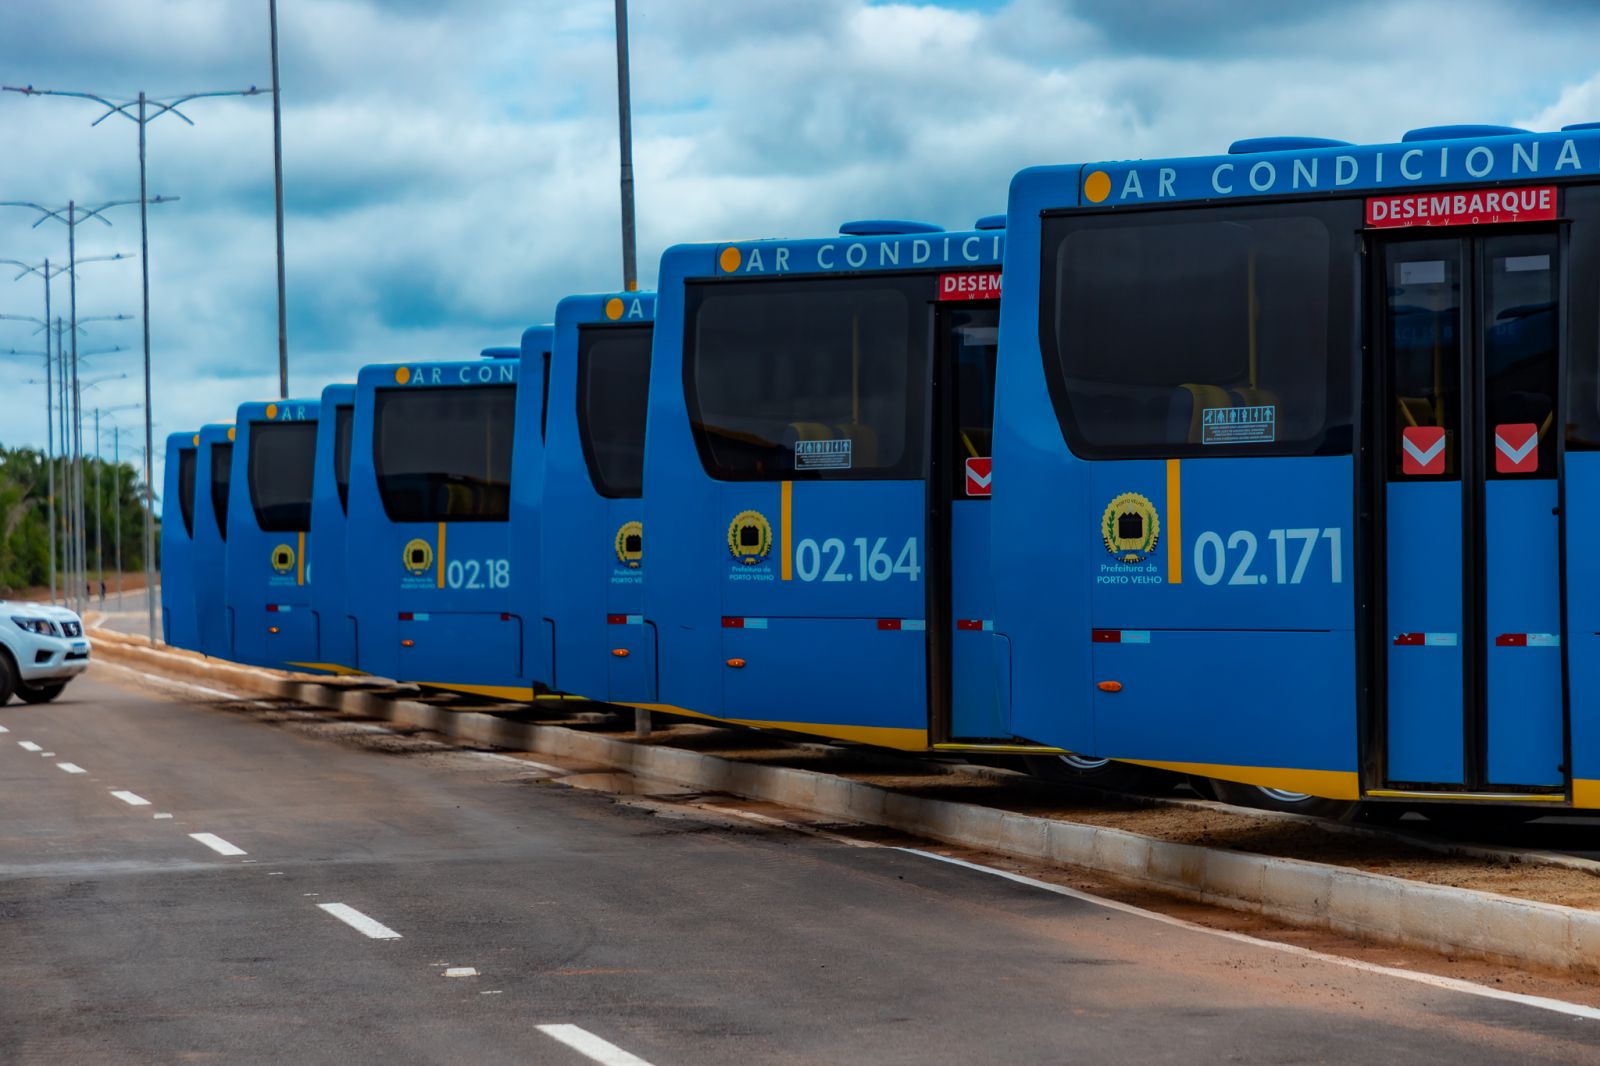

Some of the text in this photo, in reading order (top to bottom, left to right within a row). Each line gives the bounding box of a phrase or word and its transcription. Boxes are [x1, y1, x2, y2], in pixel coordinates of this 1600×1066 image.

[1120, 139, 1582, 199] AR CONDICIONA
[1372, 189, 1551, 221] DESEMBARQUE
[746, 236, 999, 272] AR CONDICI
[944, 274, 1002, 292] DESEM
[412, 365, 513, 384] AR CON
[281, 405, 305, 421] AR
[795, 536, 921, 582] 02.164
[1100, 563, 1158, 573] Prefeitura de
[1193, 527, 1342, 586] 02.171
[1097, 576, 1162, 584] PORTO VELHO
